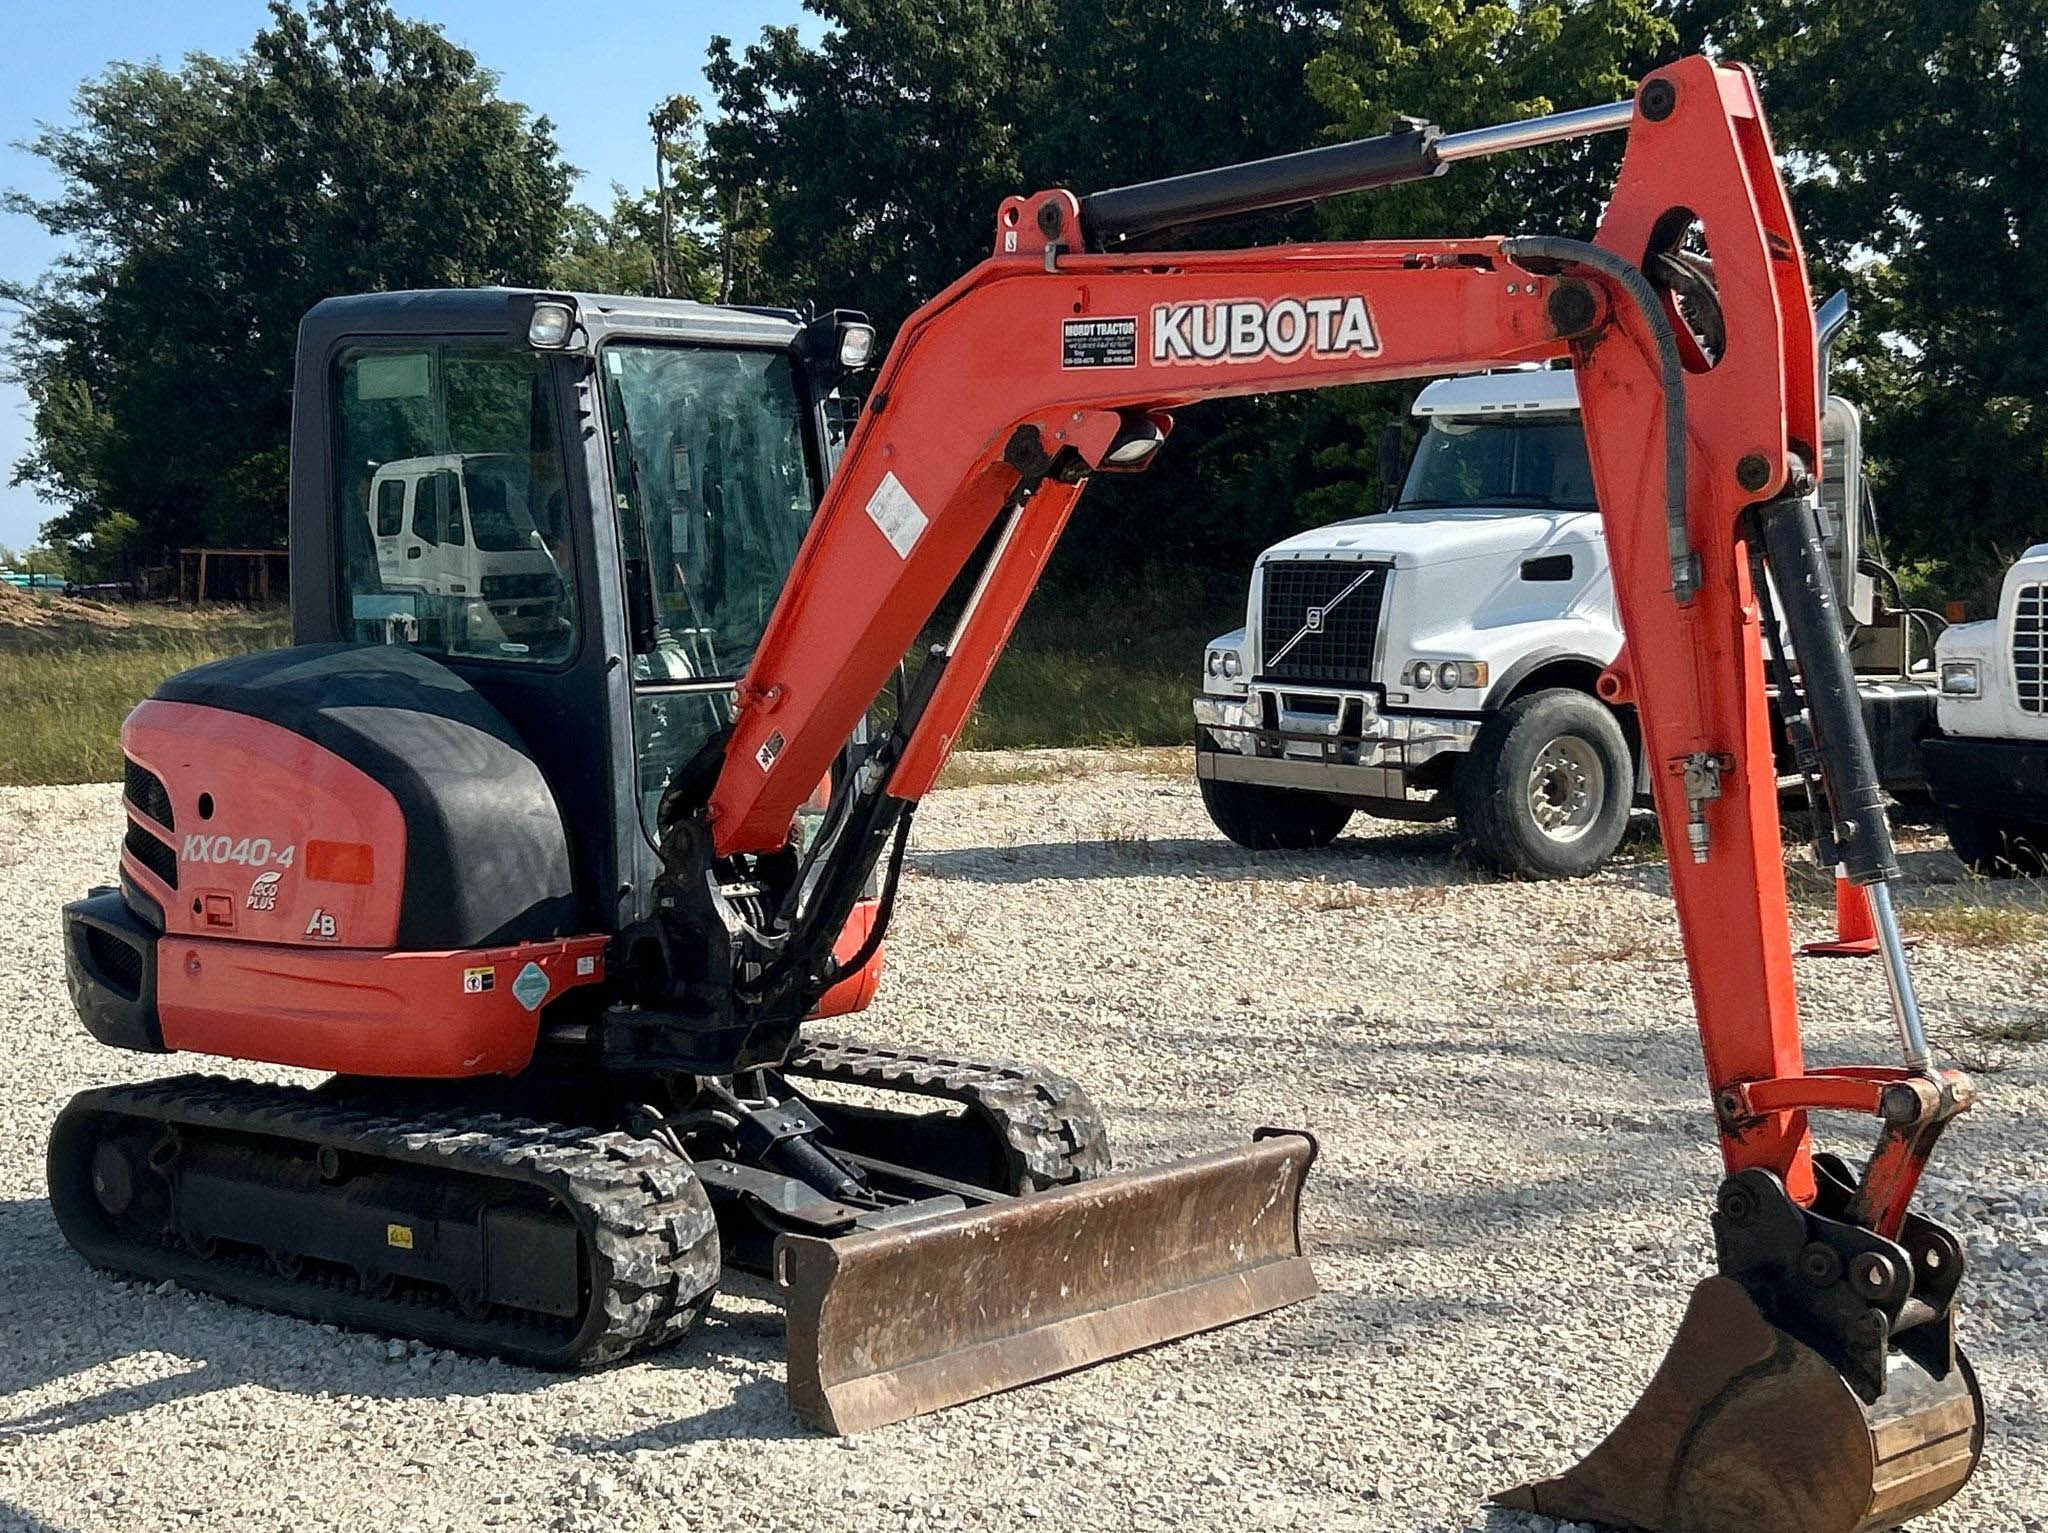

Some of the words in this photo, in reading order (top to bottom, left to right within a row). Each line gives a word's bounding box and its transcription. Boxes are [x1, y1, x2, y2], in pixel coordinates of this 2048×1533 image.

[1096, 322, 1135, 335] TRACTOR
[1153, 296, 1379, 360] KUBOTA
[181, 834, 296, 868] KX040-4
[254, 883, 278, 897] eco
[247, 896, 277, 910] PLUS
[305, 908, 338, 937] AB
